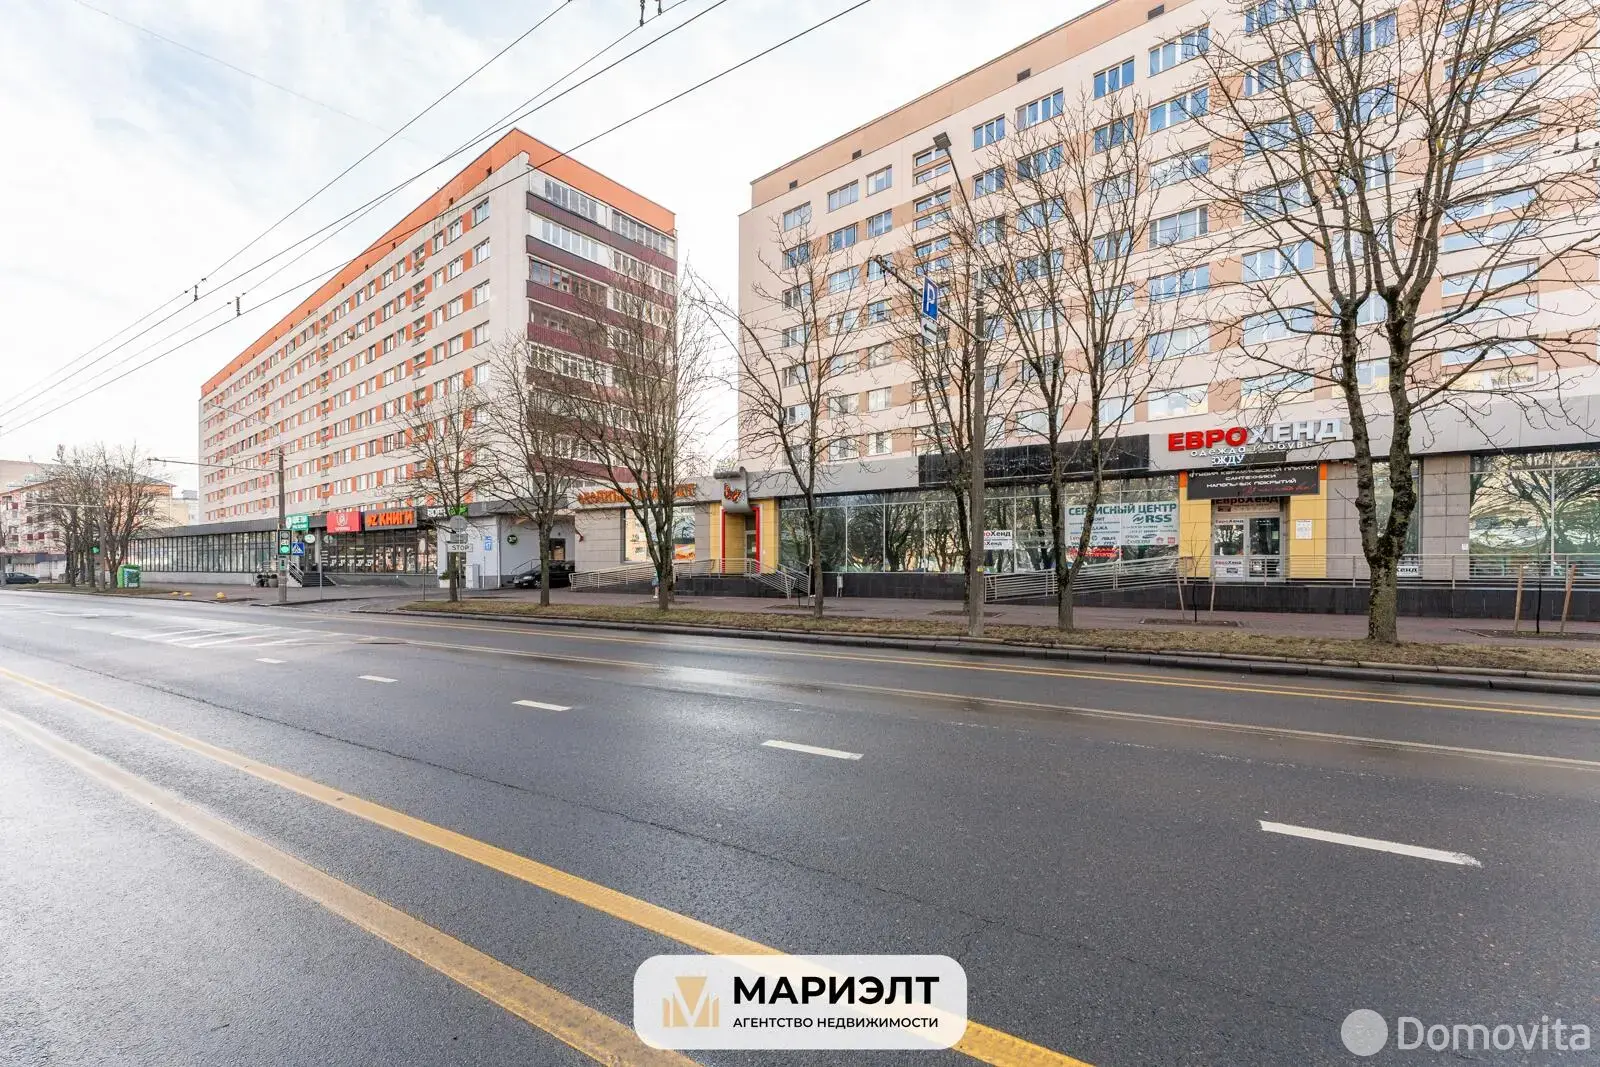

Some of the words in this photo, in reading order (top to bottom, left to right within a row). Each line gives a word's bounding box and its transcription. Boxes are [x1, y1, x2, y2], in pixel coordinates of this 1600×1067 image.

[926, 283, 935, 311] P
[380, 507, 415, 526] КНИГИ
[1069, 504, 1135, 516] СЕРИСНЫЙ
[1138, 503, 1177, 514] ЦЕНТР
[1145, 514, 1172, 523] RSS
